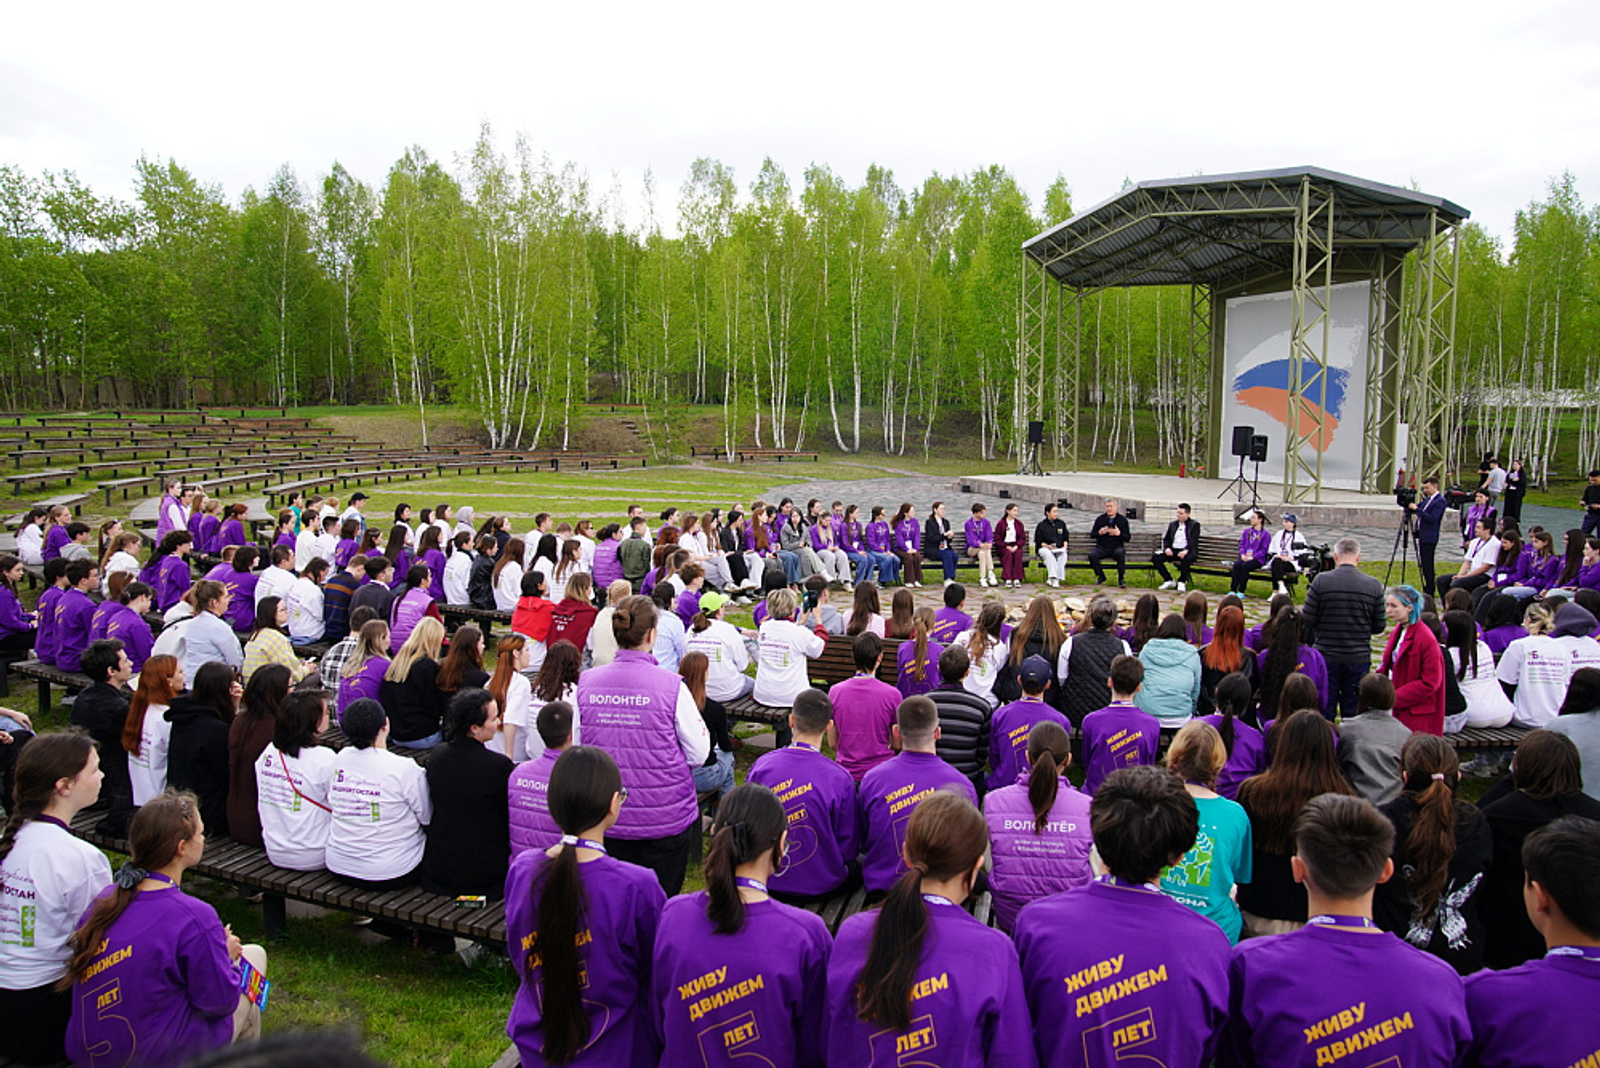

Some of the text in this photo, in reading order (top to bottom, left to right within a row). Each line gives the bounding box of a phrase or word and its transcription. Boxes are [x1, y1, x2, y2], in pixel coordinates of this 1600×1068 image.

[589, 693, 651, 706] ВОЛОНТЁР
[884, 783, 915, 804] ЖИВУ
[677, 966, 728, 1000] ЖИВУ
[1064, 954, 1124, 994] ЖИВУ
[97, 987, 119, 1009] ЛЕТ
[689, 974, 764, 1022] ДВИЖЕМ
[1076, 964, 1168, 1018] ДВИЖЕМ
[723, 1021, 755, 1047] ЛЕТ
[1113, 1020, 1151, 1048] ЛЕТ
[1303, 1002, 1366, 1044] ЖИВУ
[896, 1026, 932, 1054] ЛЕТ
[1315, 1012, 1414, 1067] ДВИЖЕМ
